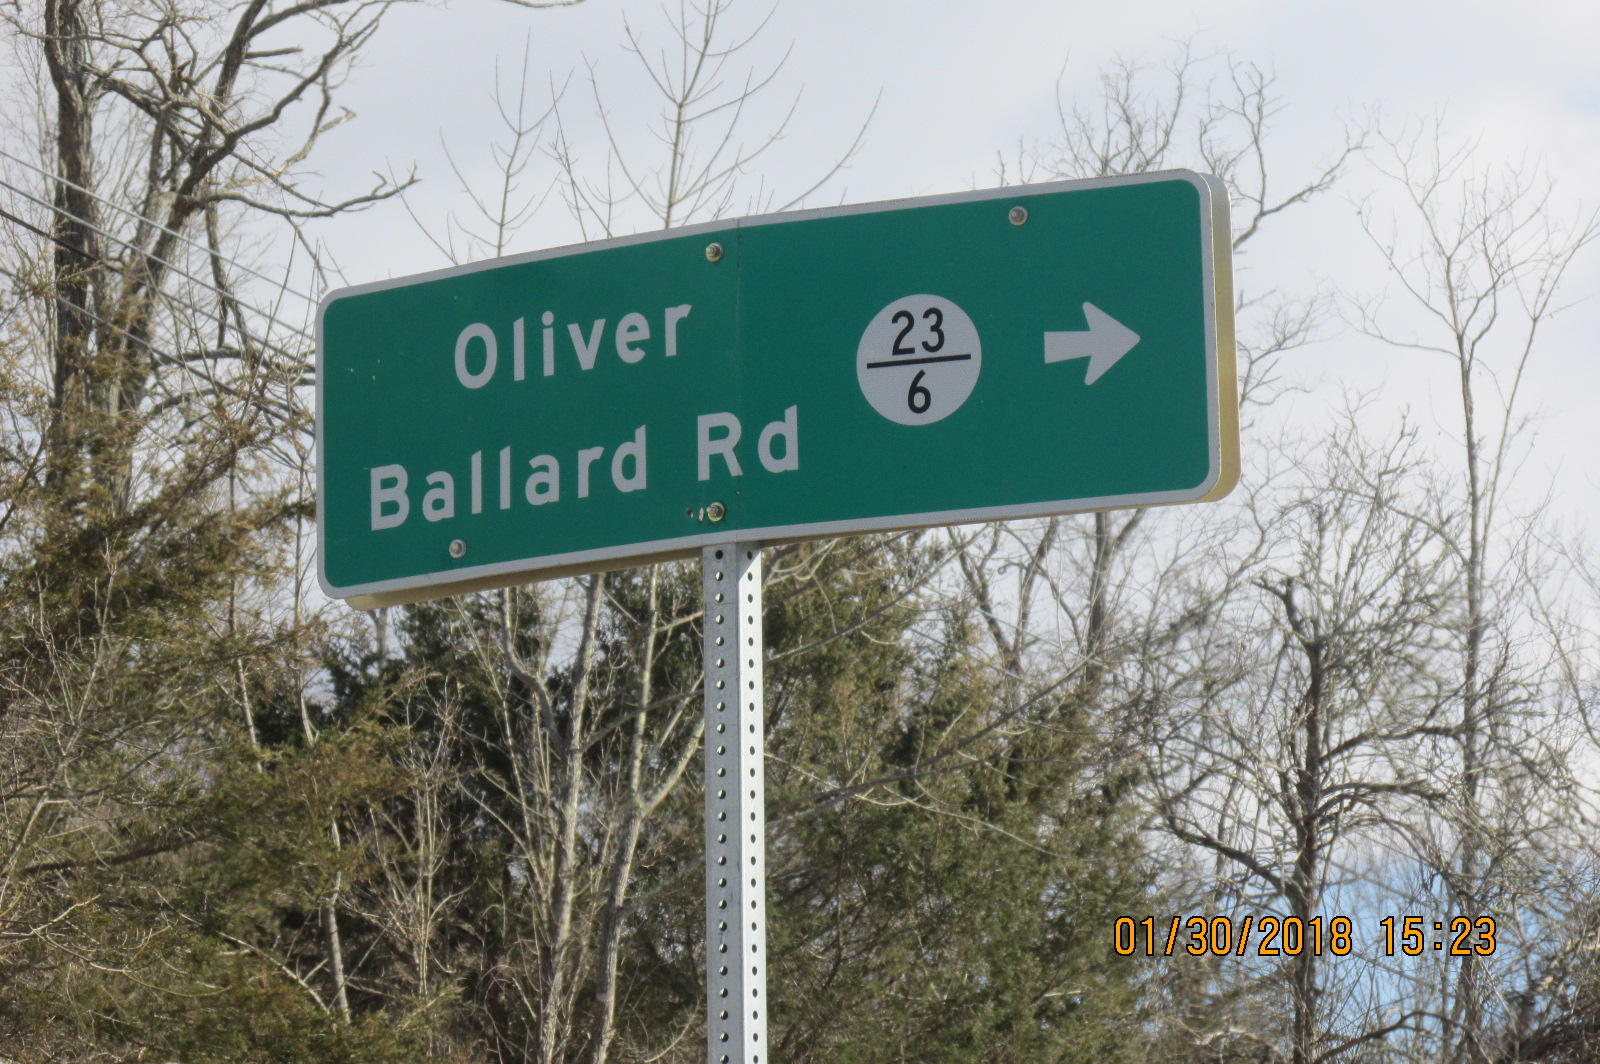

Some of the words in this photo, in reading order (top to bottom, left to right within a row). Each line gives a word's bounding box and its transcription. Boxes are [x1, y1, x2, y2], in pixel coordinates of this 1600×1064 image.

[454, 304, 692, 390] Oliver
[891, 307, 946, 357] 23
[907, 369, 932, 415] 6
[370, 426, 648, 532] Ballard
[695, 405, 799, 482] Rd
